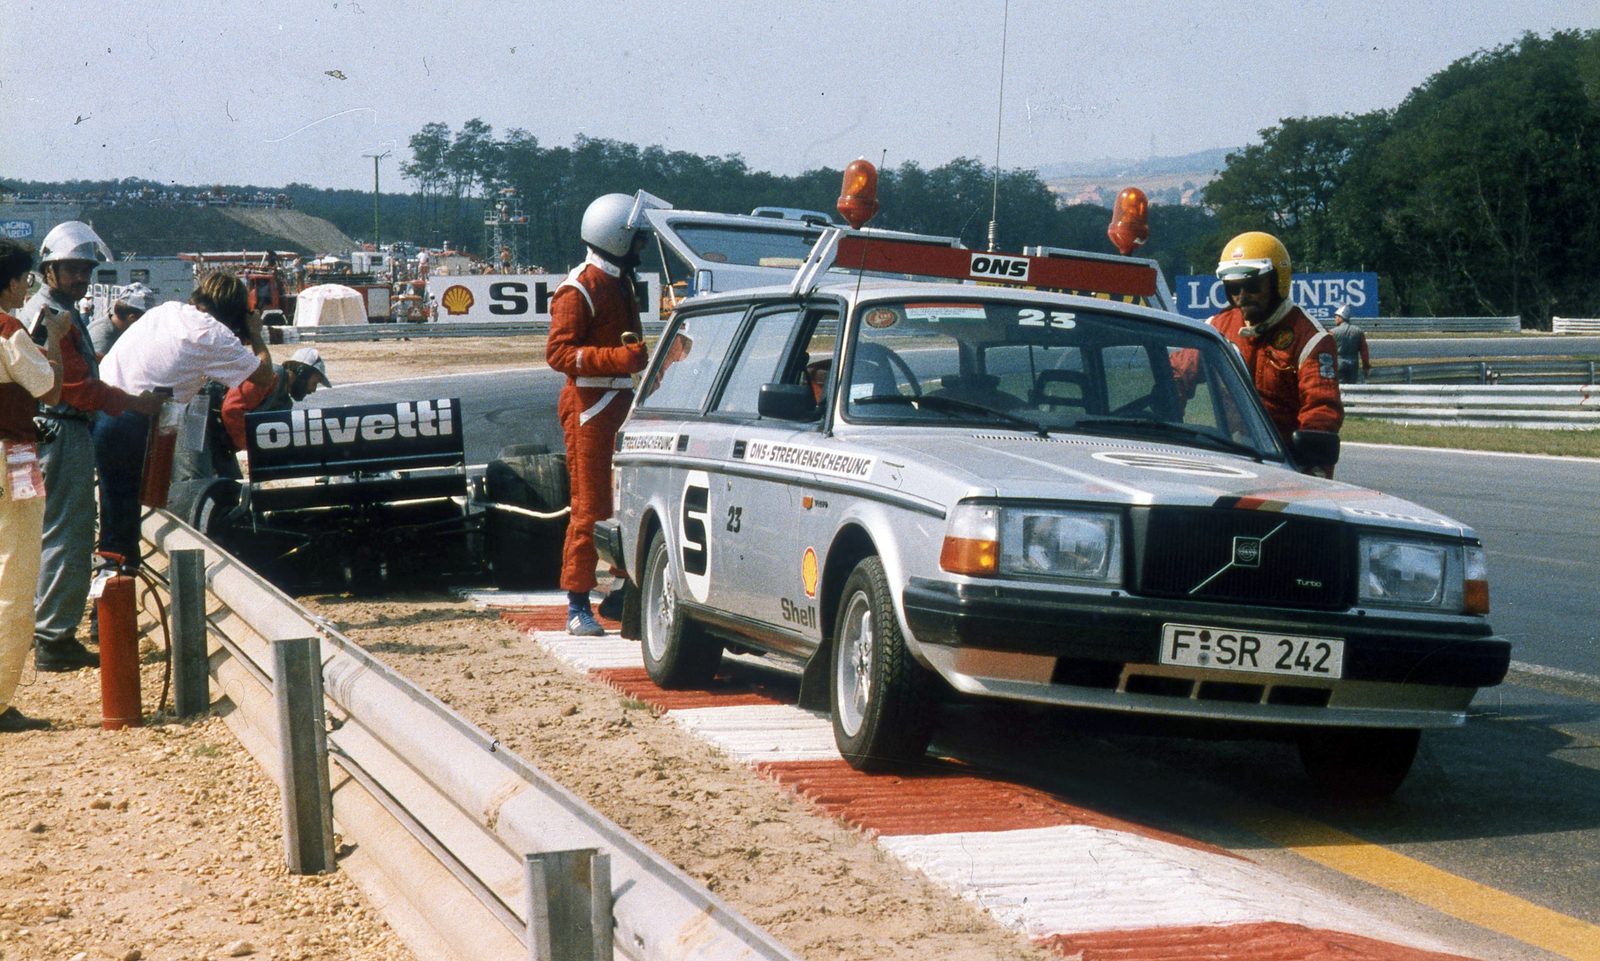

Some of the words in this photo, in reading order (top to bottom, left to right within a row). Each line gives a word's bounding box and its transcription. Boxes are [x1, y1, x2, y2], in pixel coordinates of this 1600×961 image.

[971, 257, 1028, 277] ONS
[489, 281, 649, 315] Shl
[1188, 279, 1367, 308] LOINES
[1018, 308, 1076, 329] 23
[256, 398, 453, 449] olivetti
[726, 506, 743, 533] 23
[1296, 579, 1322, 587] Turbo
[781, 598, 816, 629] Shell
[1275, 640, 1331, 673] 242
